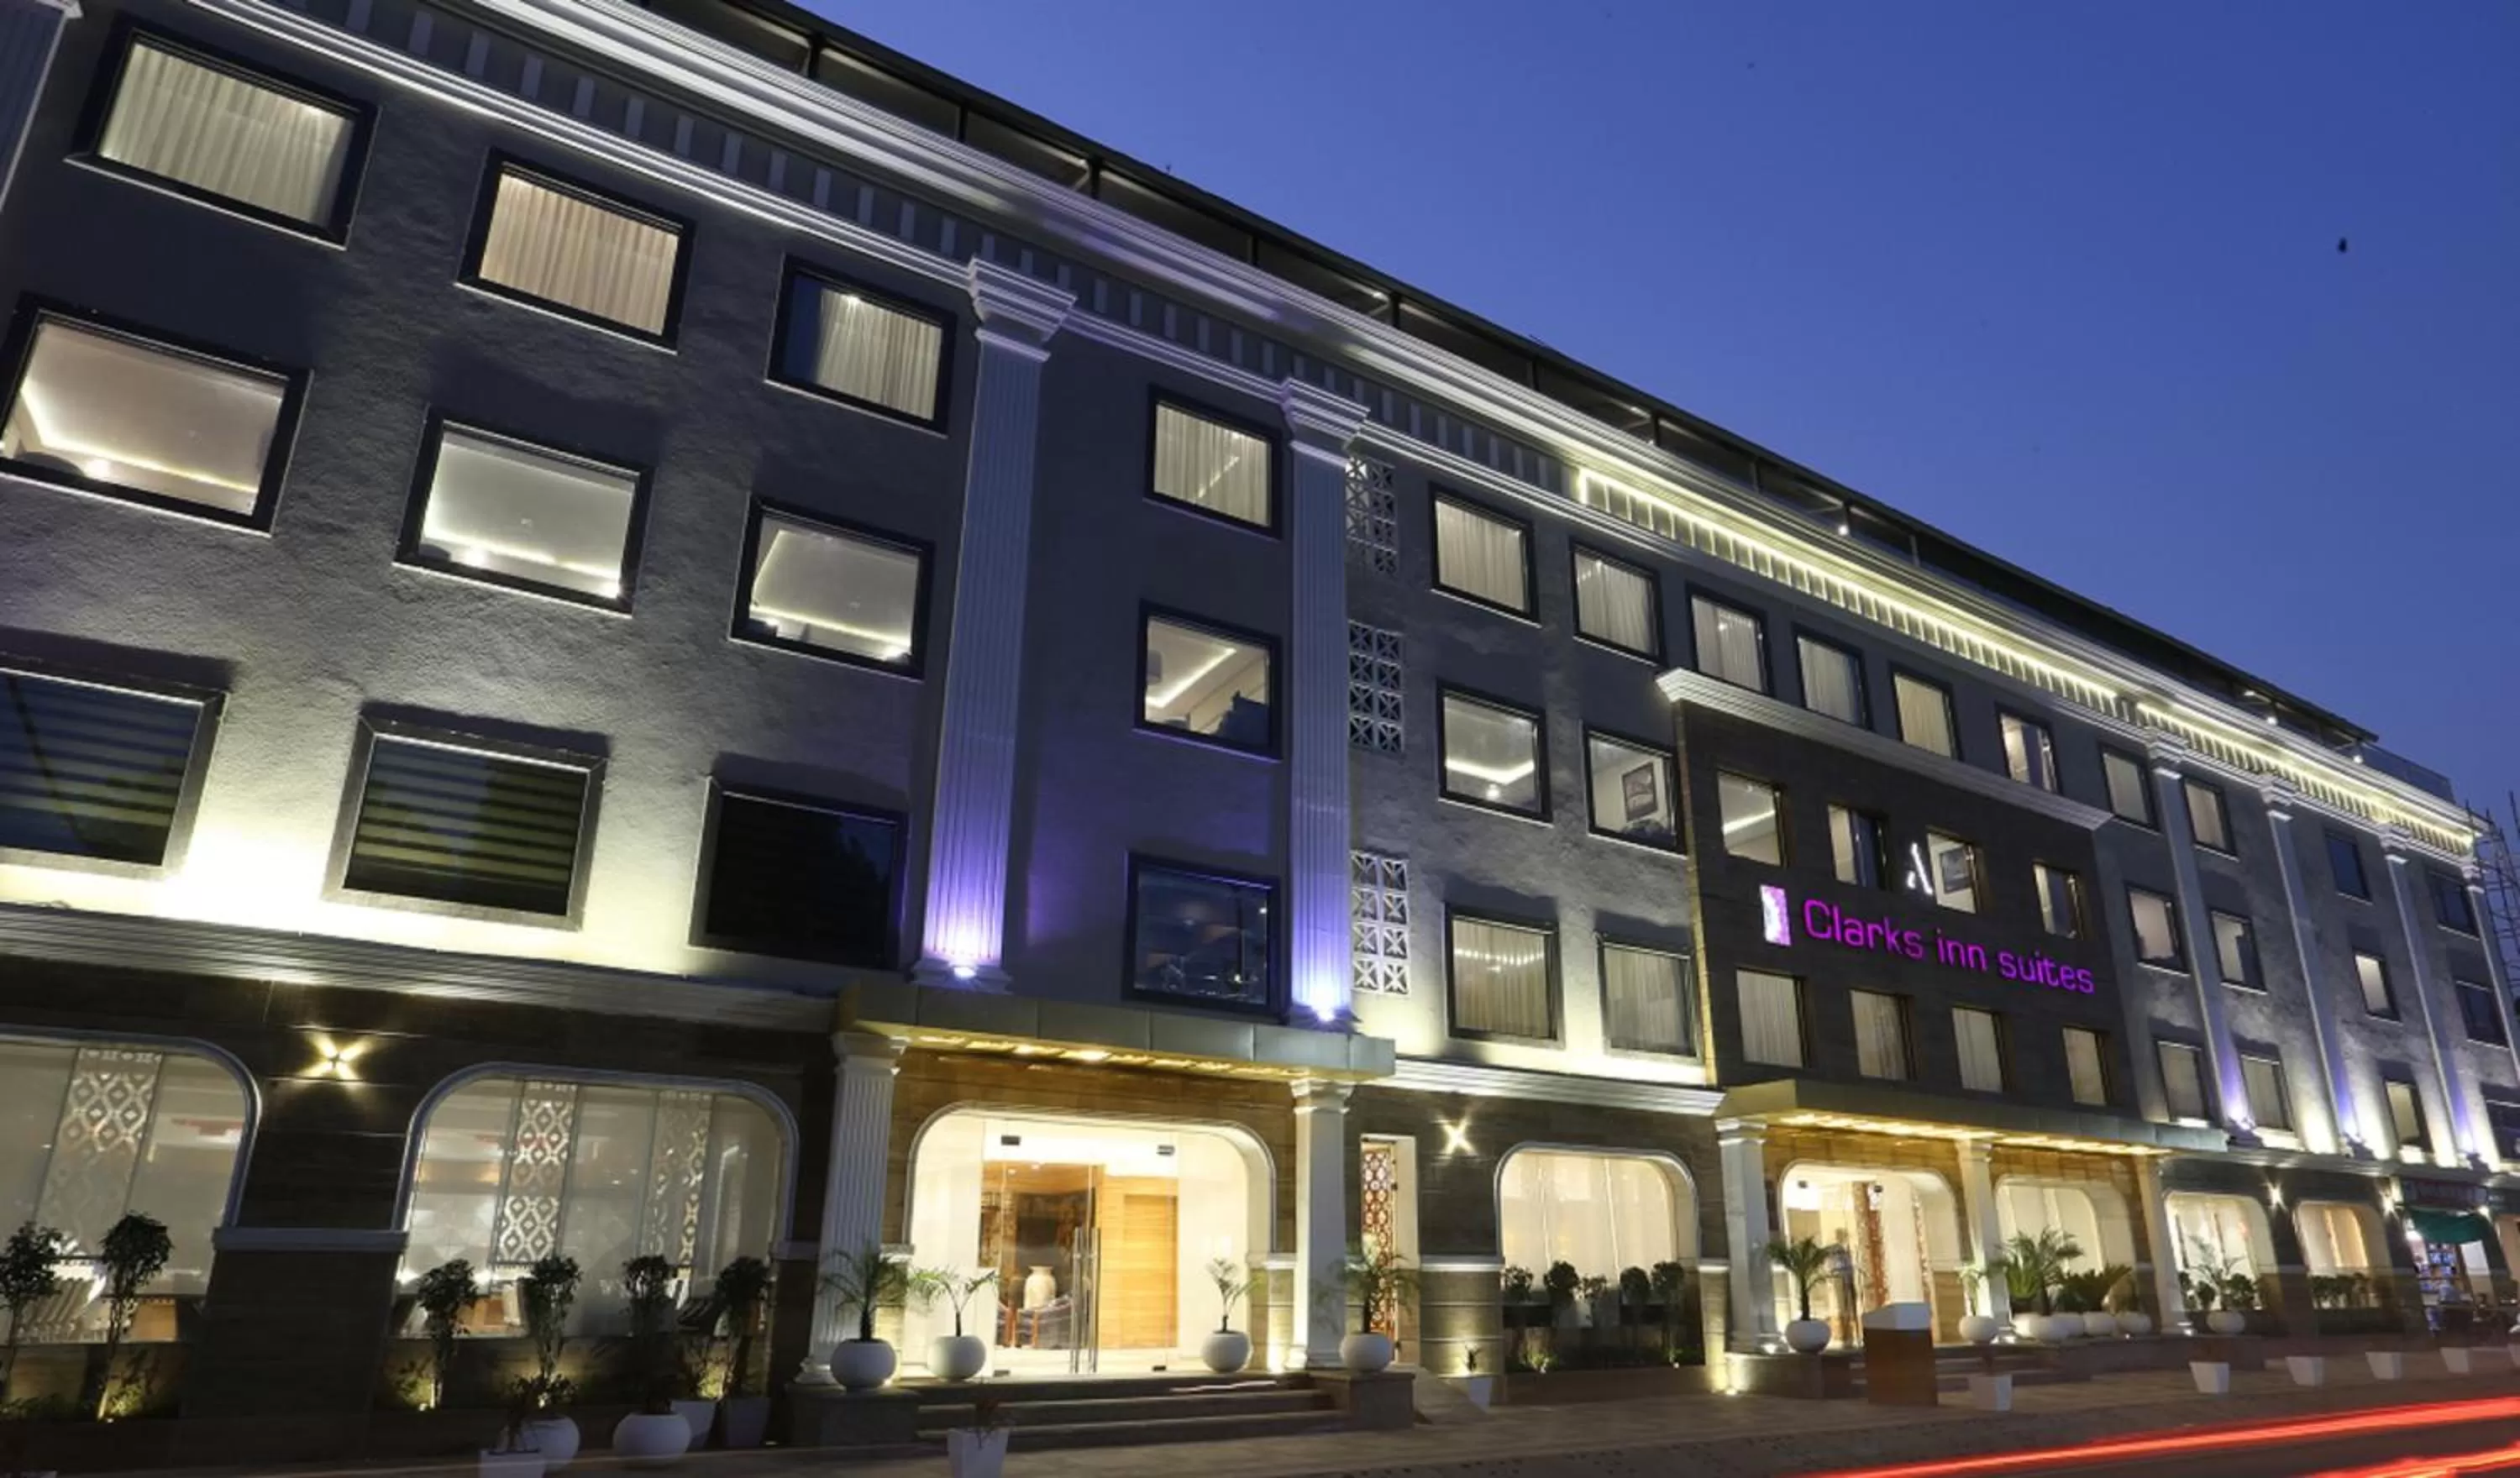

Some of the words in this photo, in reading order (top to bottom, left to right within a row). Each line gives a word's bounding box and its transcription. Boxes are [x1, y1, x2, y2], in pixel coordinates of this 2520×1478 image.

[1803, 899, 1924, 960] Clarks
[1935, 927, 1987, 972] inn
[1998, 950, 2096, 995] suites
